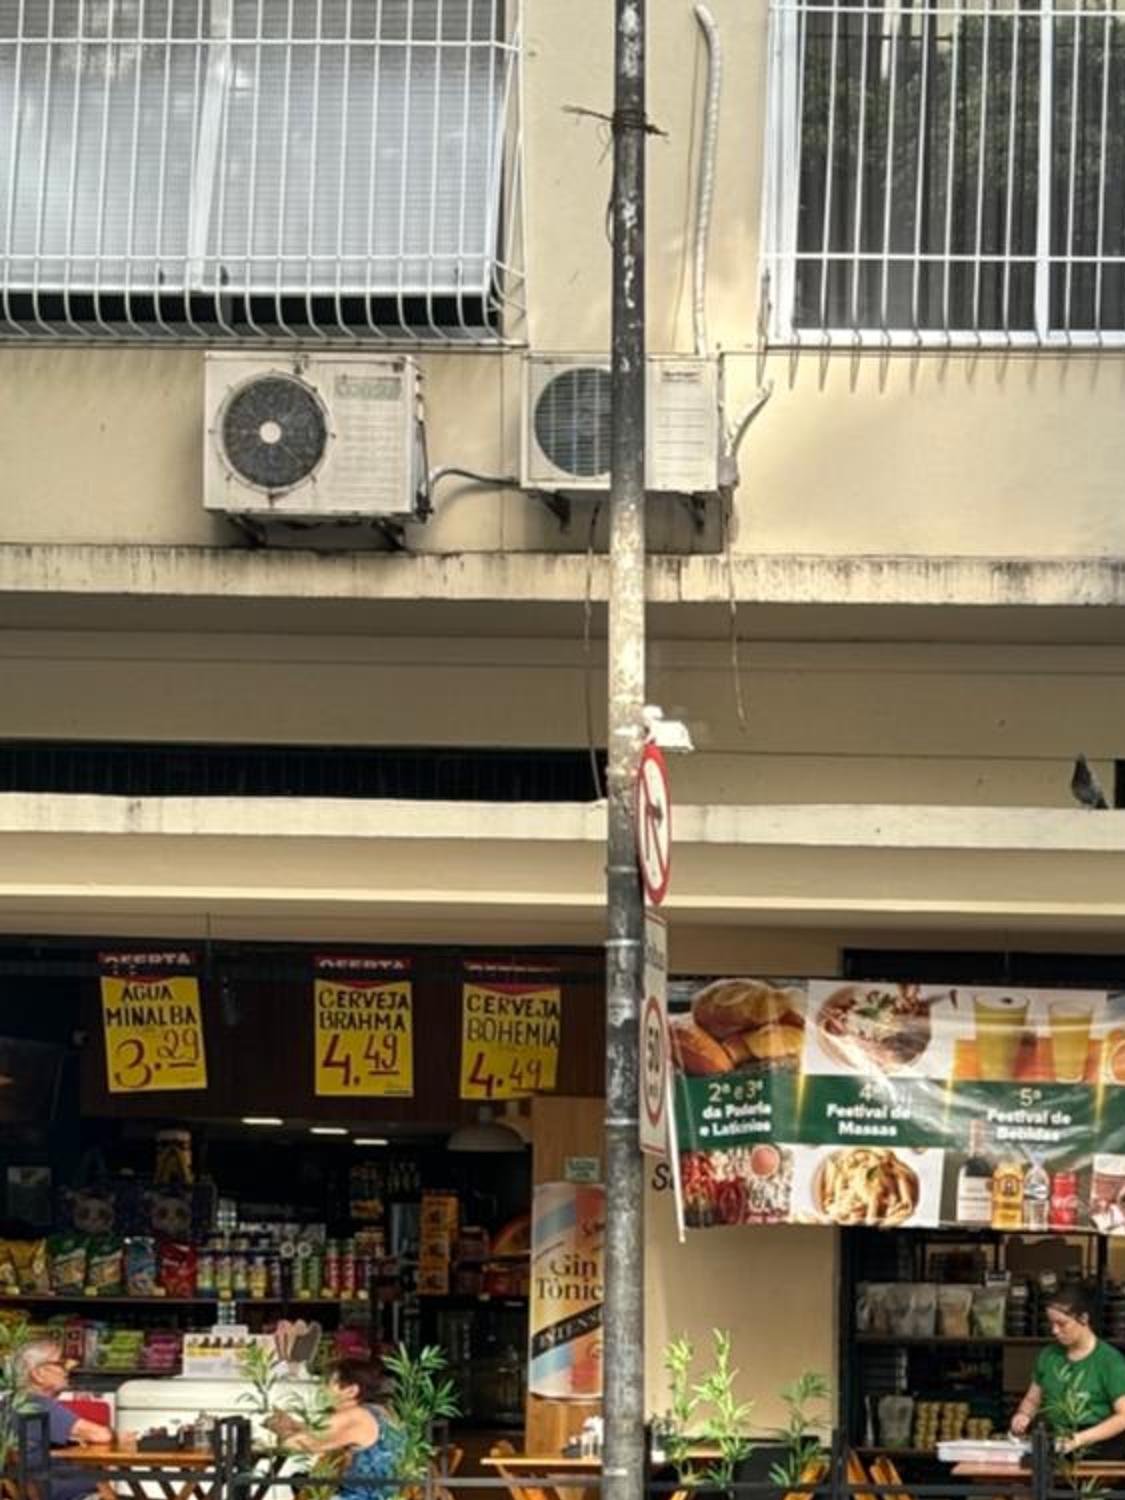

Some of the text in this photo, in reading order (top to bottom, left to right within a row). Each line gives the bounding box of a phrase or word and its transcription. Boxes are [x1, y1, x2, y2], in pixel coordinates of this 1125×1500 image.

[318, 988, 410, 1010] CERVEJA
[466, 994, 560, 1019] CERVEJA
[105, 1005, 198, 1027] MINALBA
[318, 1010, 407, 1033] BRAHMA
[467, 1017, 560, 1047] BOHEMIA
[701, 1104, 723, 1120] da
[826, 1103, 888, 1119] Festival
[987, 1107, 1072, 1125] Festival de
[700, 1125, 710, 1137] e
[838, 1121, 898, 1137] Massas
[551, 1253, 598, 1277] Gin
